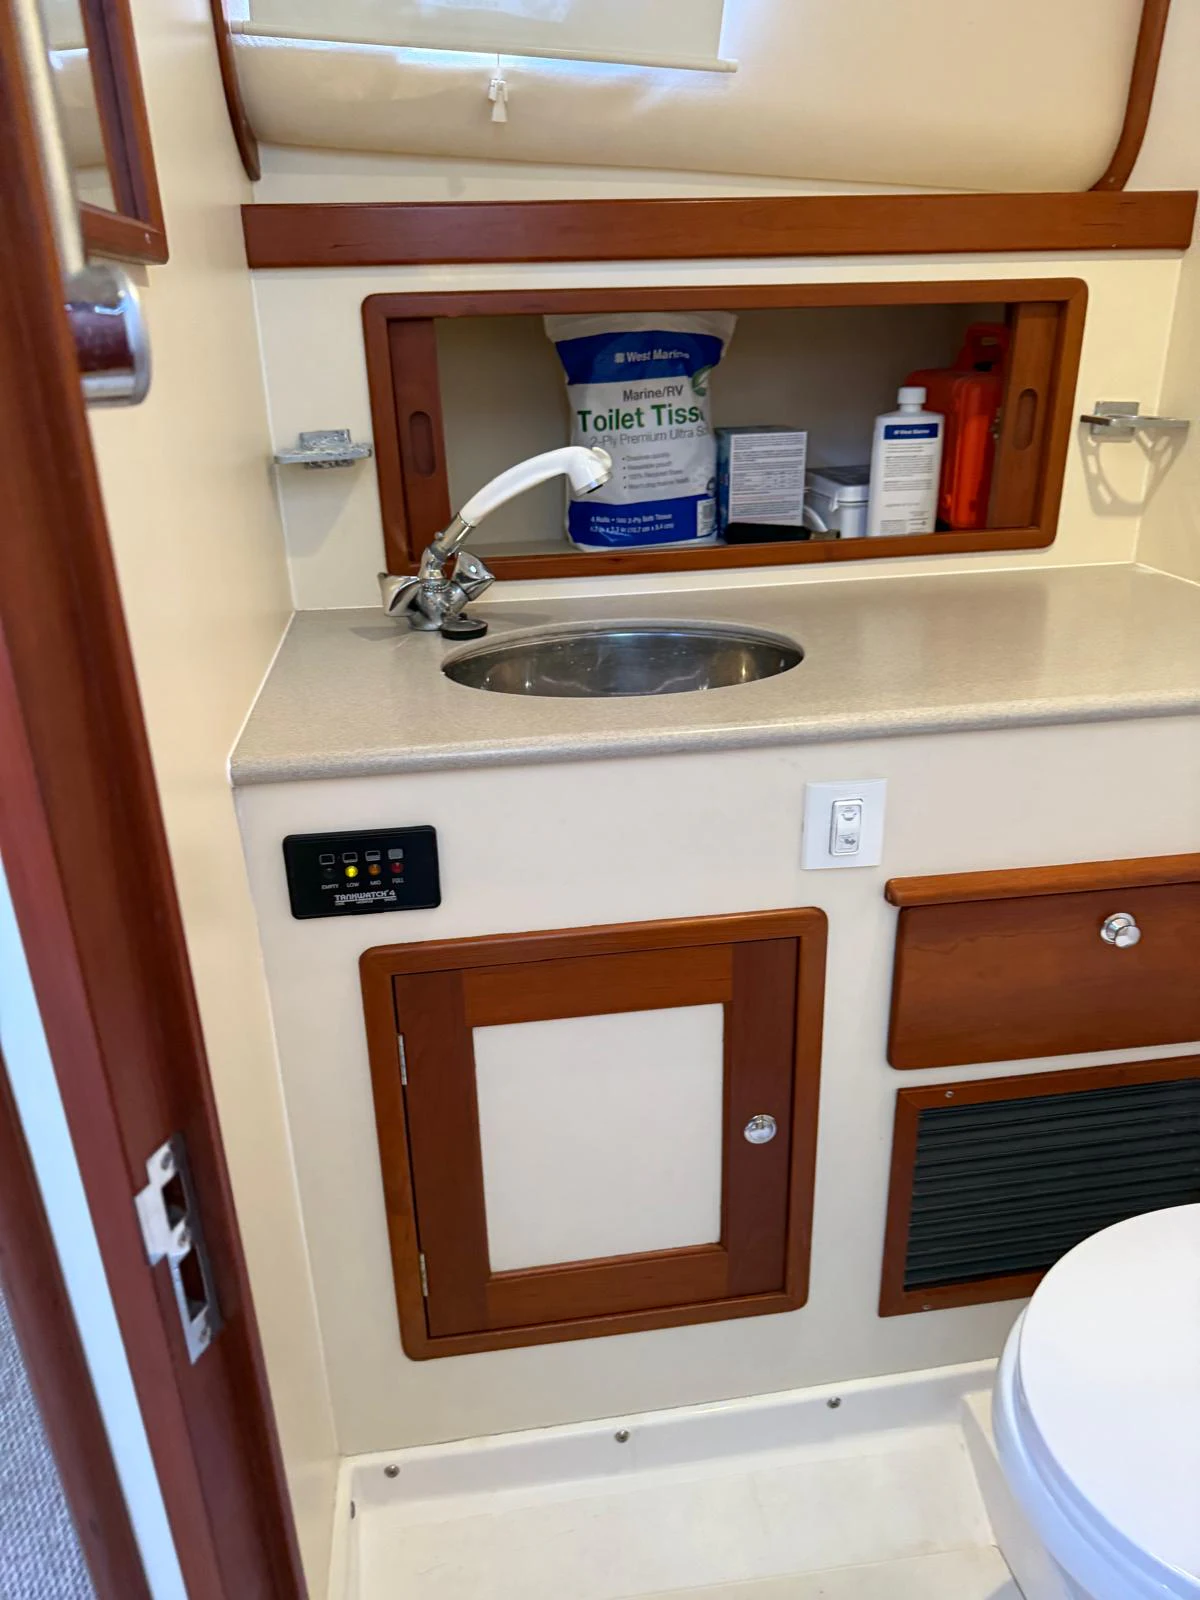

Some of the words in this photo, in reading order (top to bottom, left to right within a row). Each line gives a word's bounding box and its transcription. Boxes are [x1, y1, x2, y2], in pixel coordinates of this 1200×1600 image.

[626, 350, 651, 362] West
[623, 384, 684, 402] Marine/RV
[576, 406, 645, 432] Toilet
[590, 435, 617, 448] 2-Ply
[619, 432, 667, 445] Premium
[669, 428, 694, 440] Ultra
